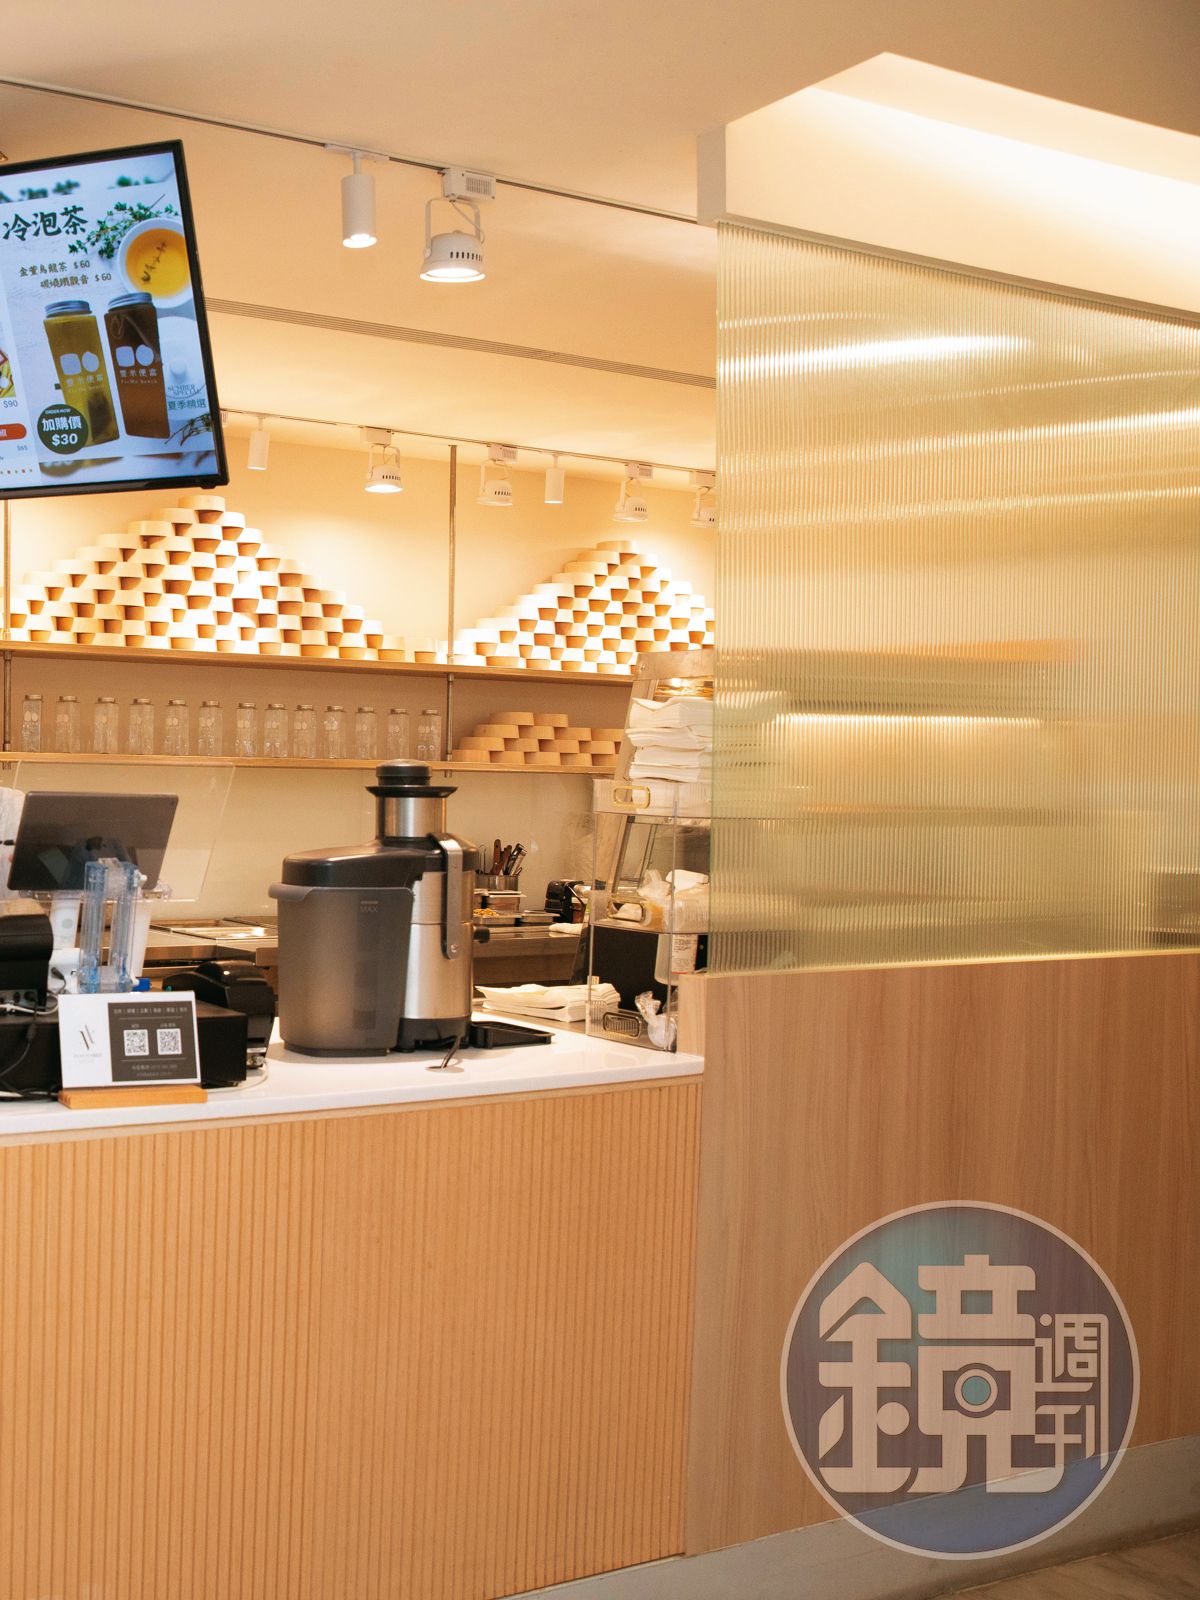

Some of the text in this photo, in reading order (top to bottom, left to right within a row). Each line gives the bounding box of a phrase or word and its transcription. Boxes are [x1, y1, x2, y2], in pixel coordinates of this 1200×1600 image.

[2, 204, 88, 241] 冷泡茶
[3, 400, 18, 408] $90
[42, 415, 82, 432] 加購價
[51, 433, 78, 446] $30
